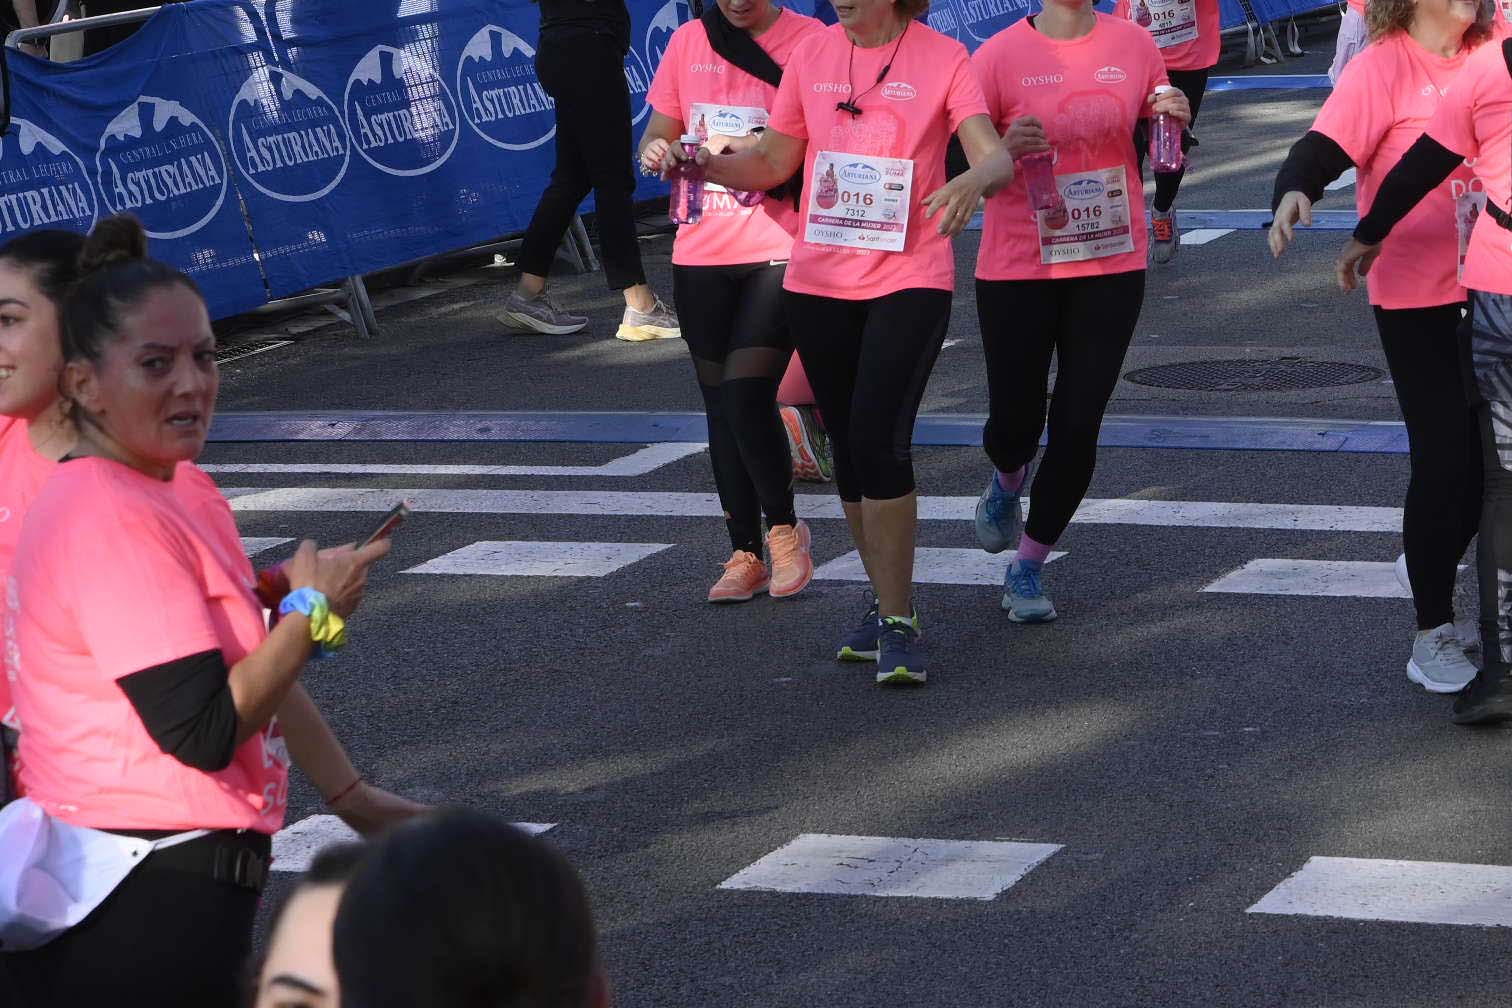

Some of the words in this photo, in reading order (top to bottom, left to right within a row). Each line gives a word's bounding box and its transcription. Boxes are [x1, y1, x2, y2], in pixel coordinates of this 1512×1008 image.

[1153, 9, 1175, 21] 016
[512, 64, 538, 79] LECHE
[691, 63, 726, 74] OYSHO
[1022, 73, 1064, 87] OYSHO
[813, 82, 852, 93] OYSHO
[466, 75, 555, 124] ASTURIAN
[242, 123, 345, 175] ASTURIANA
[0, 166, 31, 185] TRAL
[840, 191, 874, 206] 016
[0, 181, 92, 234] TURIANA
[845, 207, 867, 218] 7312
[1071, 205, 1103, 221] 016
[817, 216, 843, 226] CARRERA
[1075, 221, 1100, 232] 15782
[813, 227, 843, 239] OYSHO
[1050, 247, 1080, 257] OYSHO
